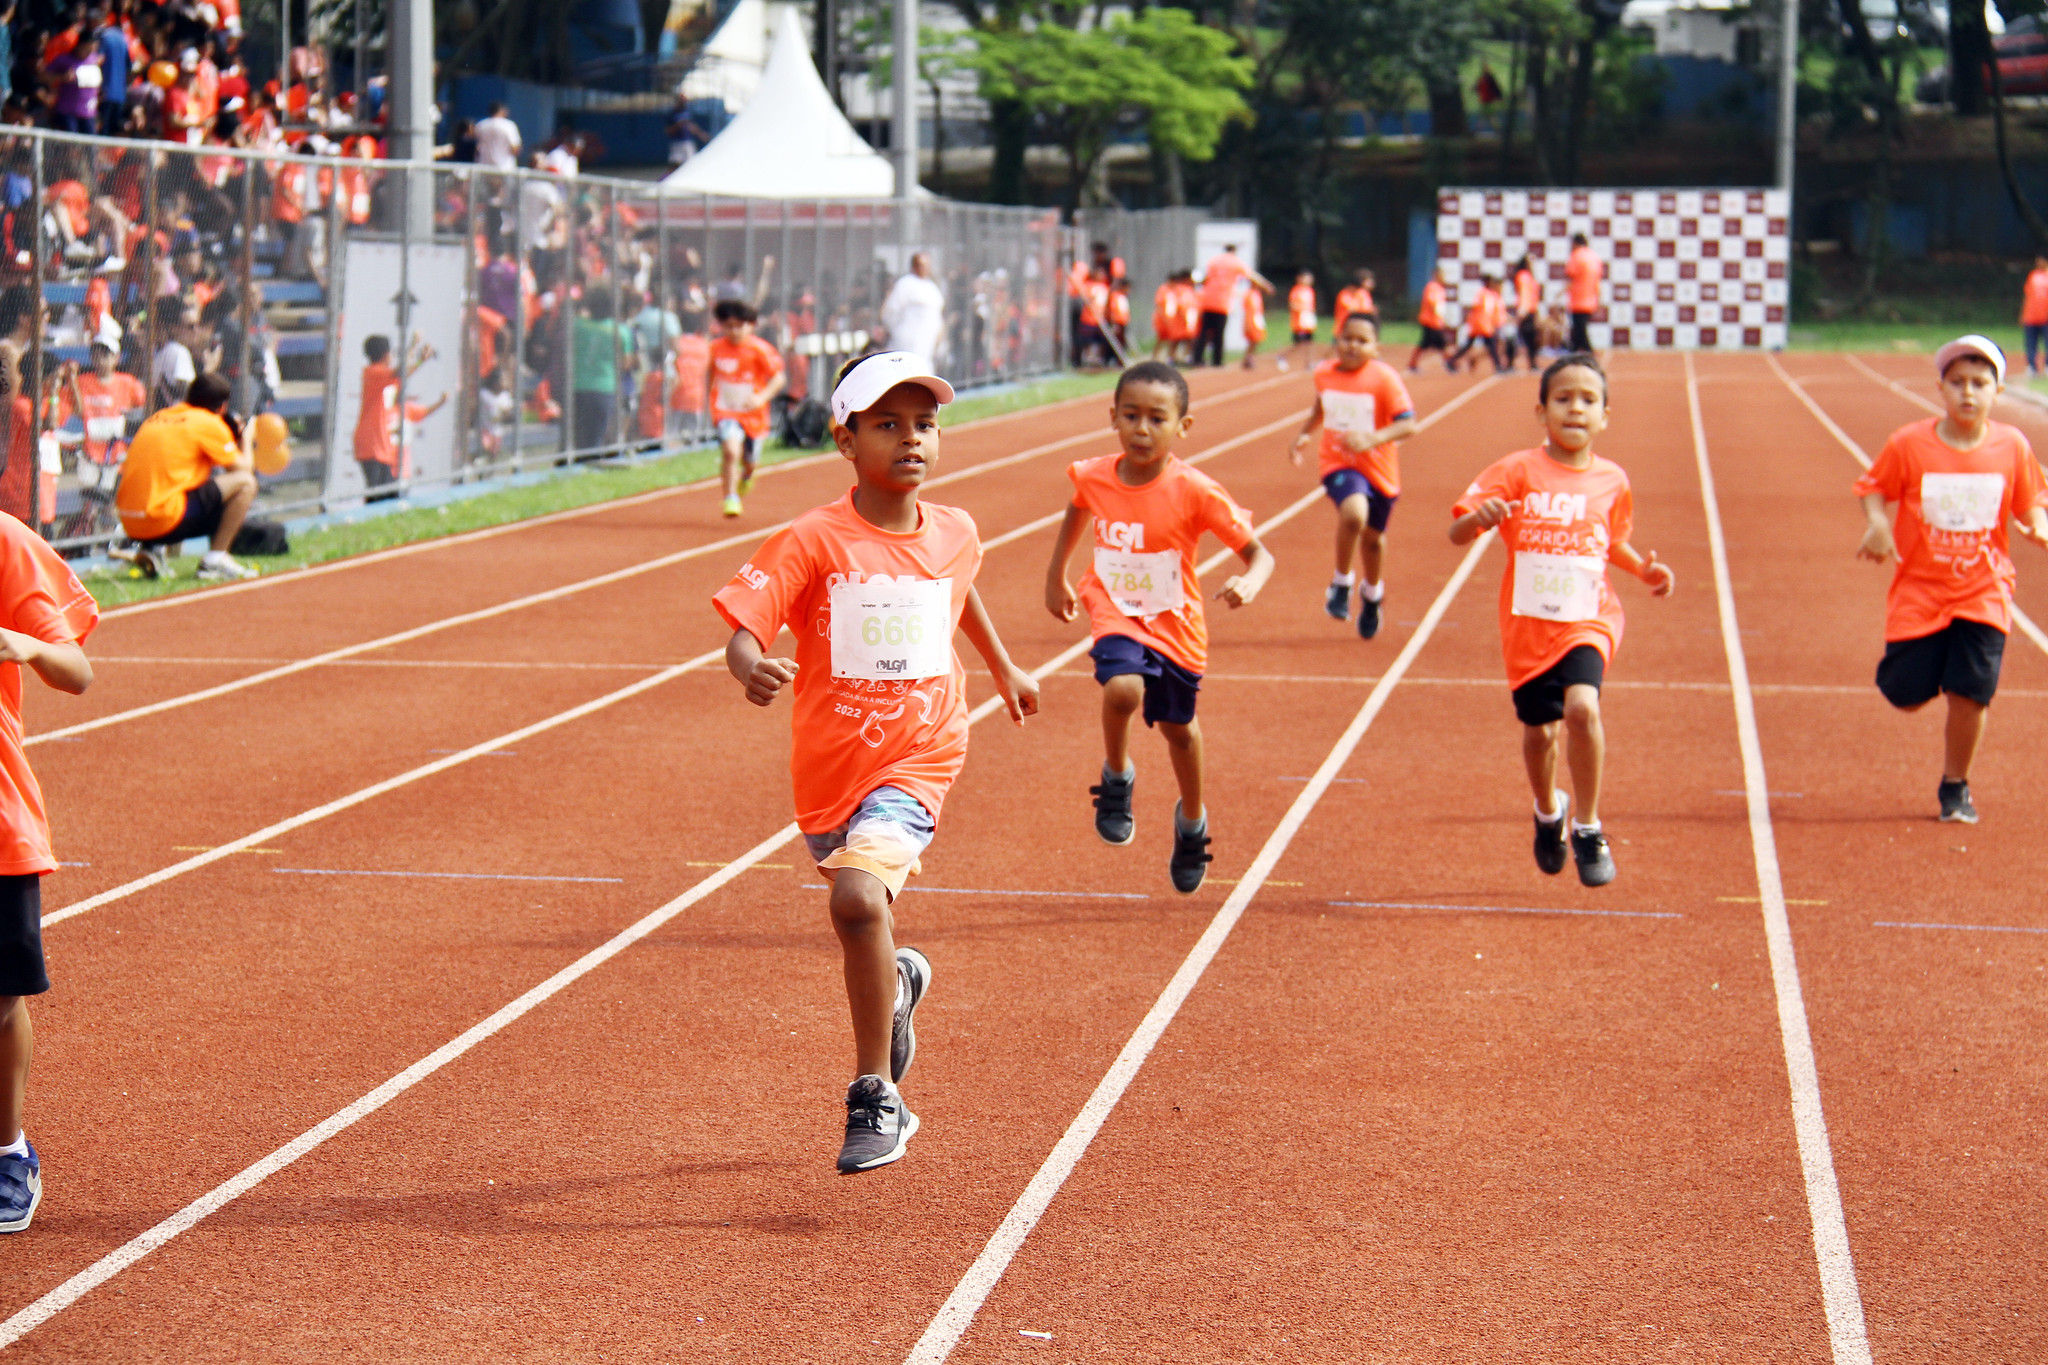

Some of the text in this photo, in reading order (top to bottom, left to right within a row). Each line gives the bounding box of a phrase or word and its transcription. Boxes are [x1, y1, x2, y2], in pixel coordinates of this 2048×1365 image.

[1108, 572, 1154, 592] 784
[1532, 574, 1576, 596] 846
[862, 615, 923, 645] 666
[834, 702, 862, 718] 2022
